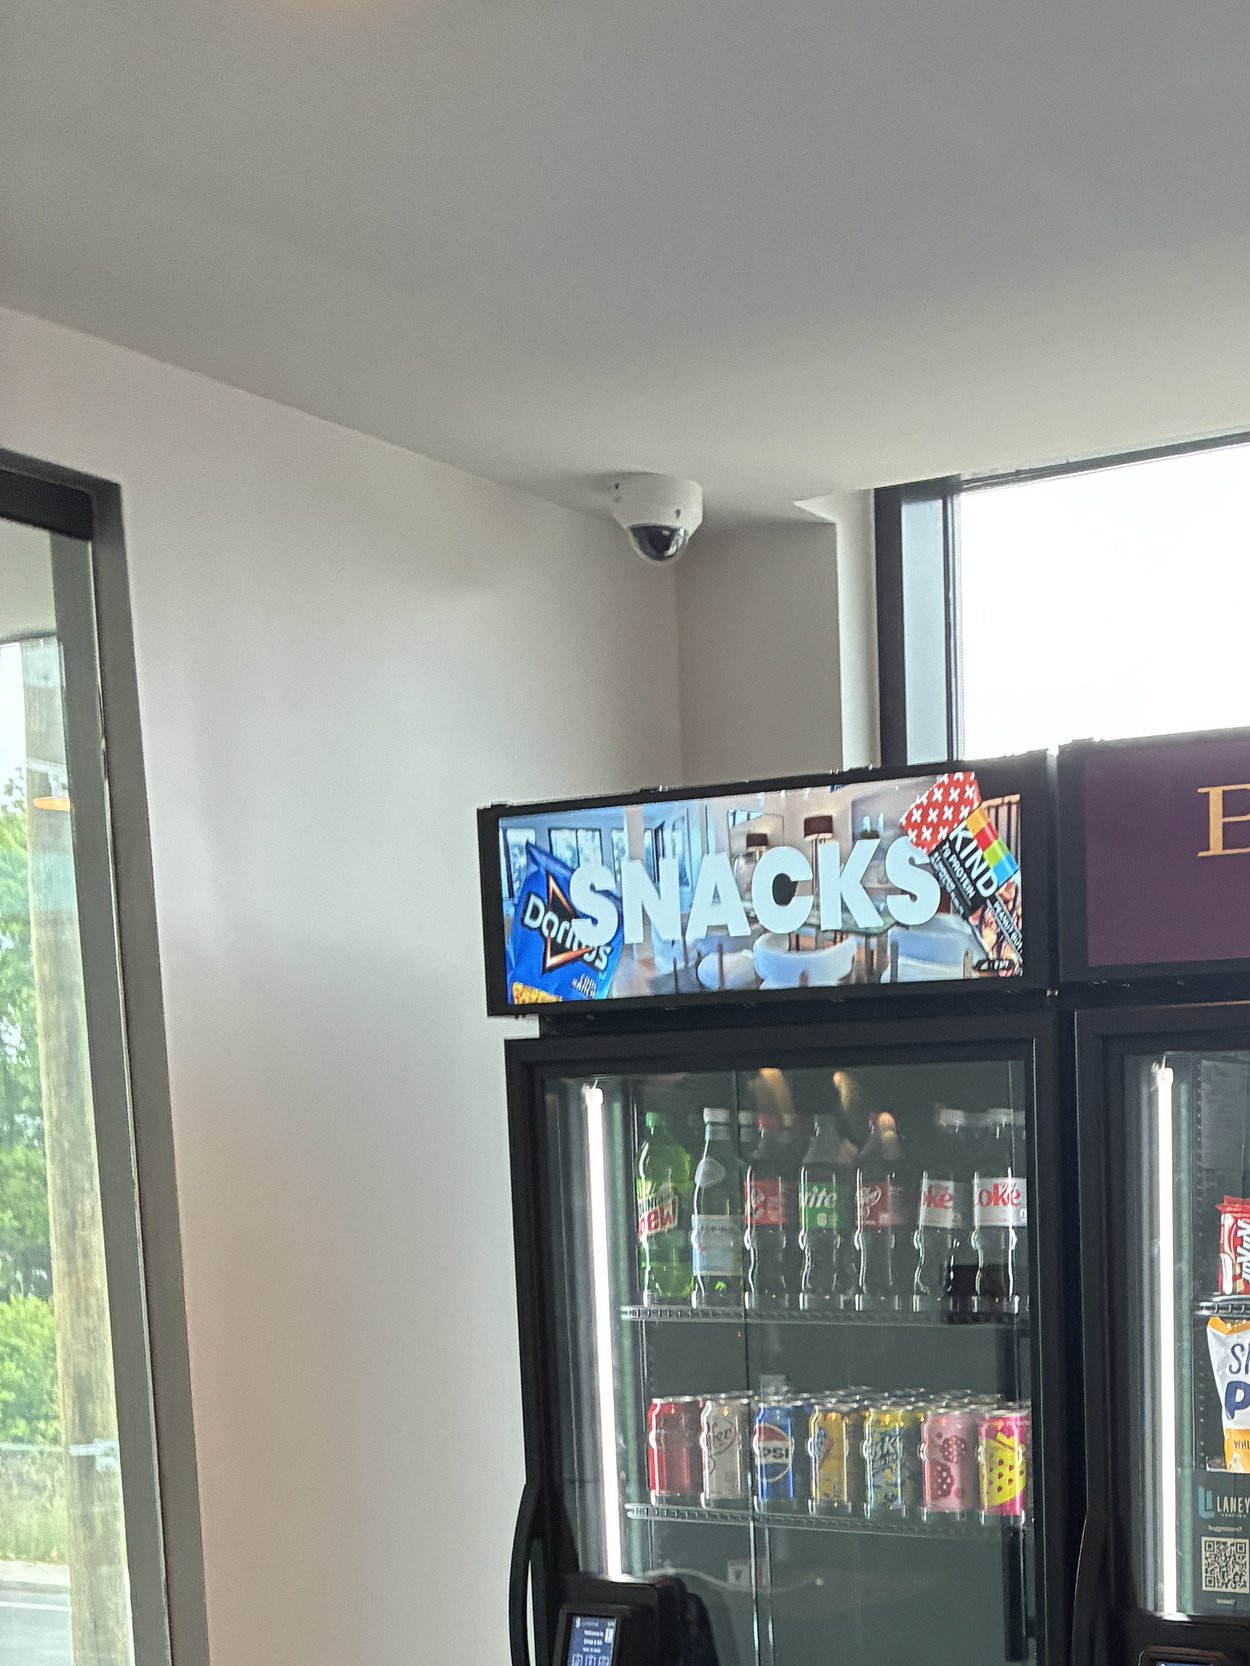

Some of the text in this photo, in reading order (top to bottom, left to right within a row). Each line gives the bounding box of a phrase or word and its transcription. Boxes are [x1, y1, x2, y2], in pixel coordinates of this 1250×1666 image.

[949, 821, 998, 898] KIND
[949, 854, 976, 900] PROTEIN
[569, 836, 941, 946] SNACKS
[523, 893, 611, 970] Doris
[799, 1186, 837, 1209] rite
[977, 1182, 1021, 1207] oke
[762, 1447, 790, 1460] PSI
